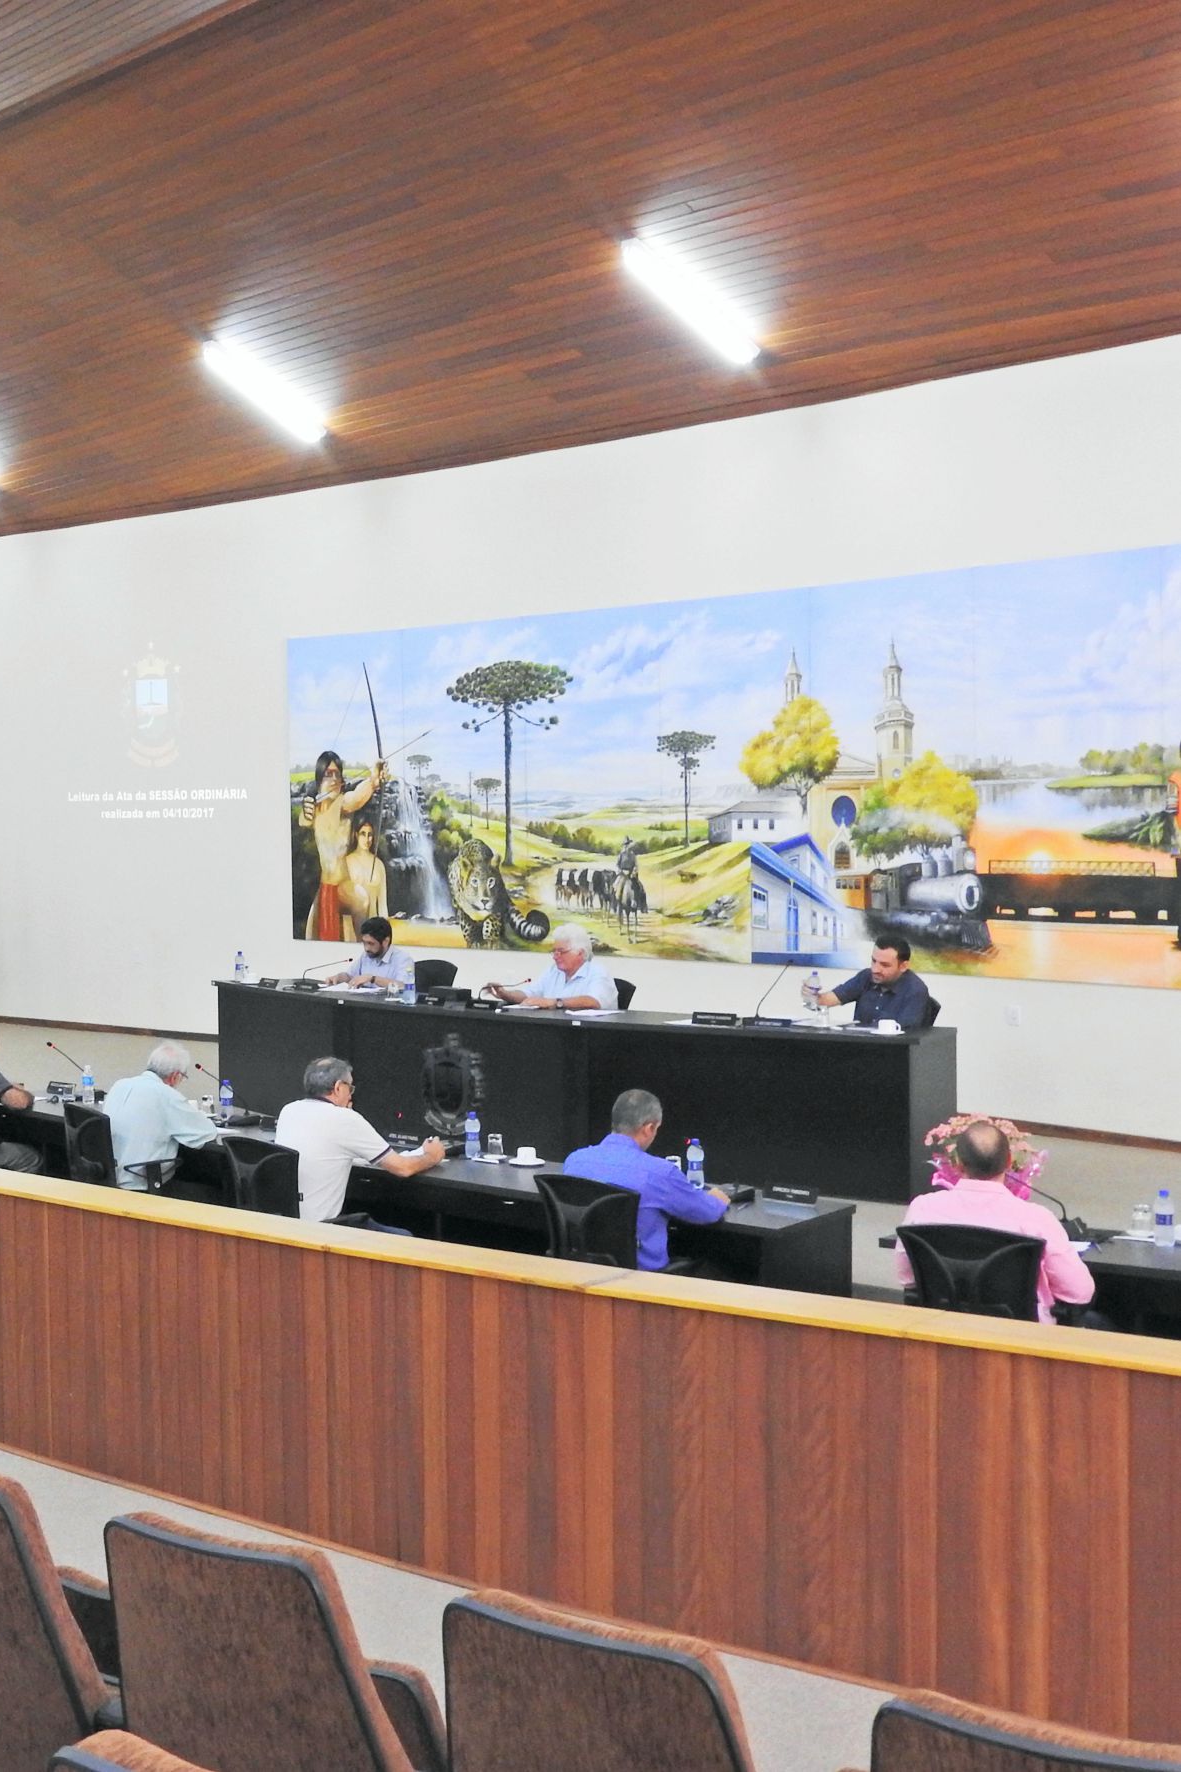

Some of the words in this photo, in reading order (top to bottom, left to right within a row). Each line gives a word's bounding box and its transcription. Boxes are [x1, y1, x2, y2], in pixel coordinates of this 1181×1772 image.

[68, 791, 100, 802] Leitura
[102, 790, 114, 801] da
[116, 791, 133, 801] Ata
[135, 790, 147, 801] da
[149, 788, 188, 801] SESSÃO
[190, 786, 248, 800] ORDINÁRIA
[101, 808, 144, 819] realizada
[146, 810, 161, 819] em
[162, 807, 215, 819] 04/10/2017
